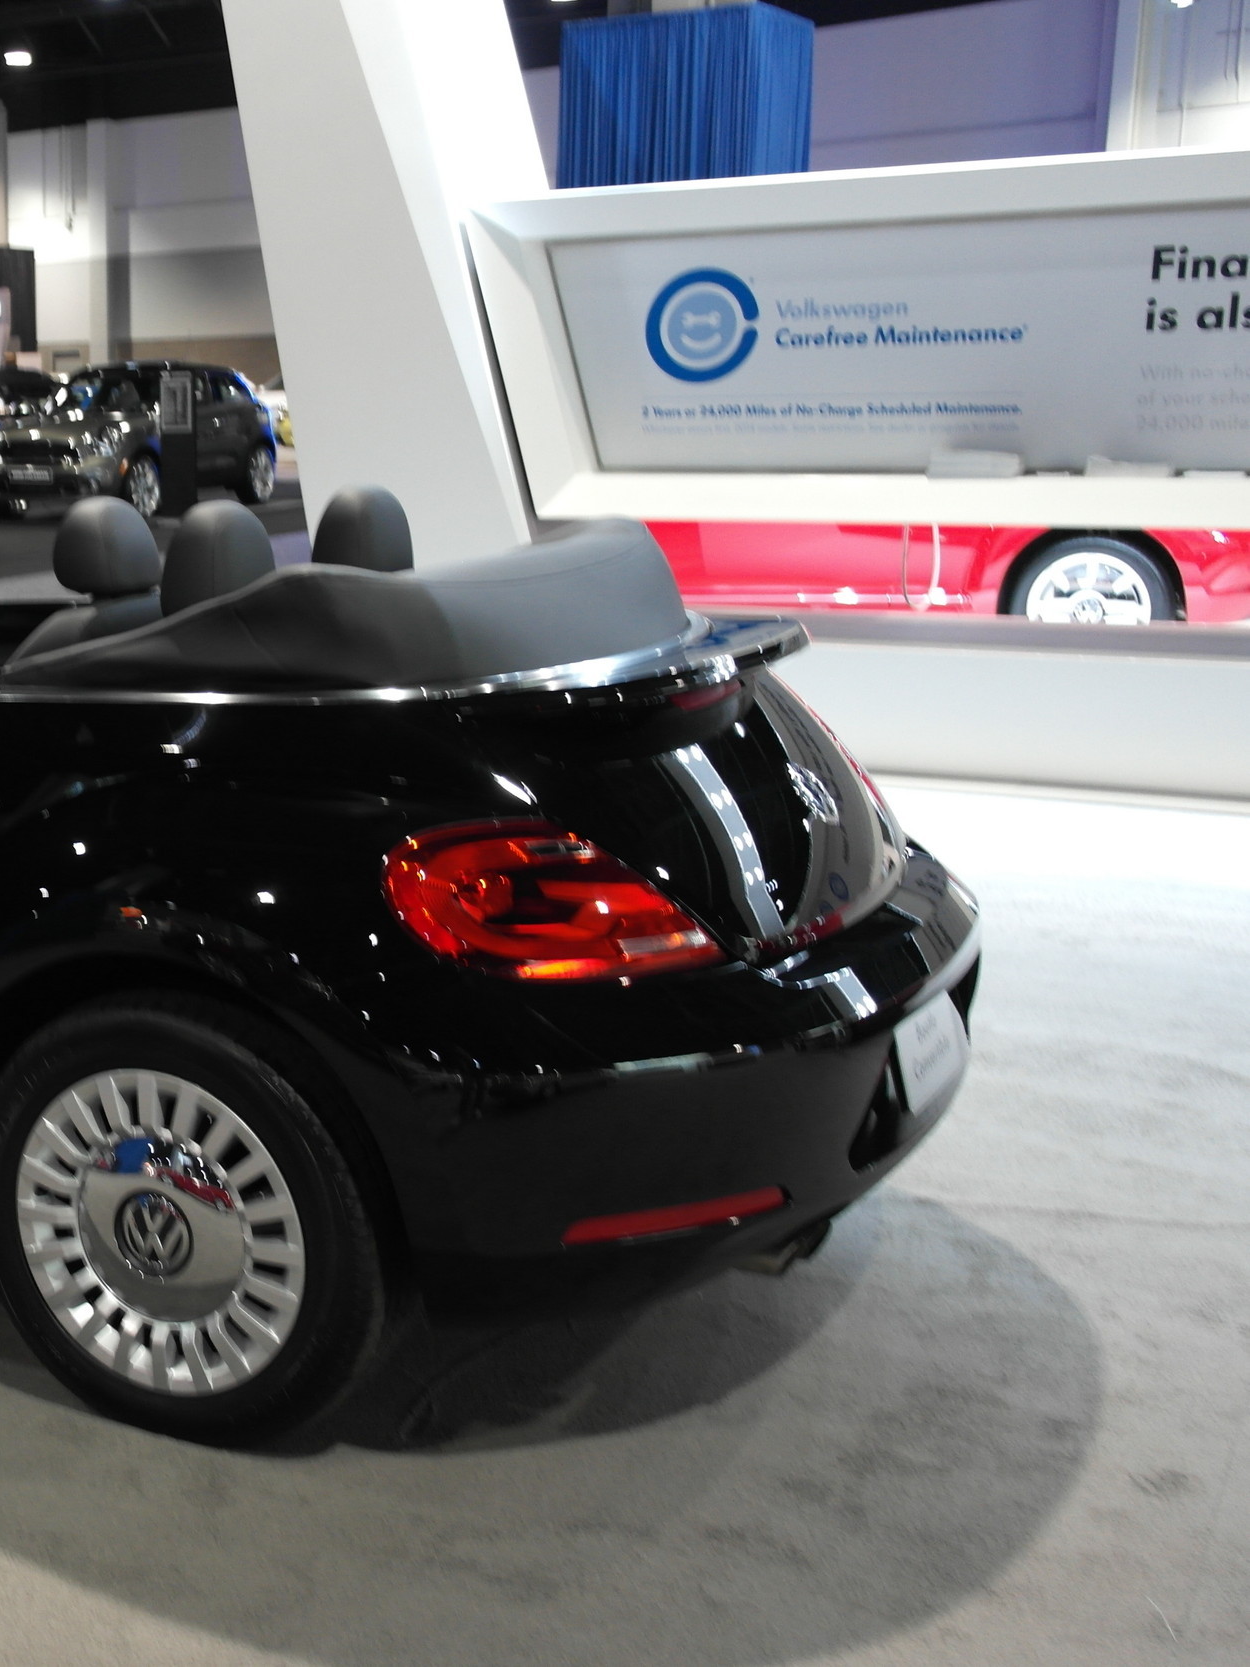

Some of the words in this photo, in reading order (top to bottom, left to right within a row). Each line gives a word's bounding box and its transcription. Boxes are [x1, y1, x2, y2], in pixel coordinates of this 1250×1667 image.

[1151, 245, 1249, 282] Fina
[775, 298, 908, 321] Volkswagen
[1146, 296, 1178, 332] is
[775, 325, 868, 348] Carefree
[867, 401, 932, 416] Scheduled
